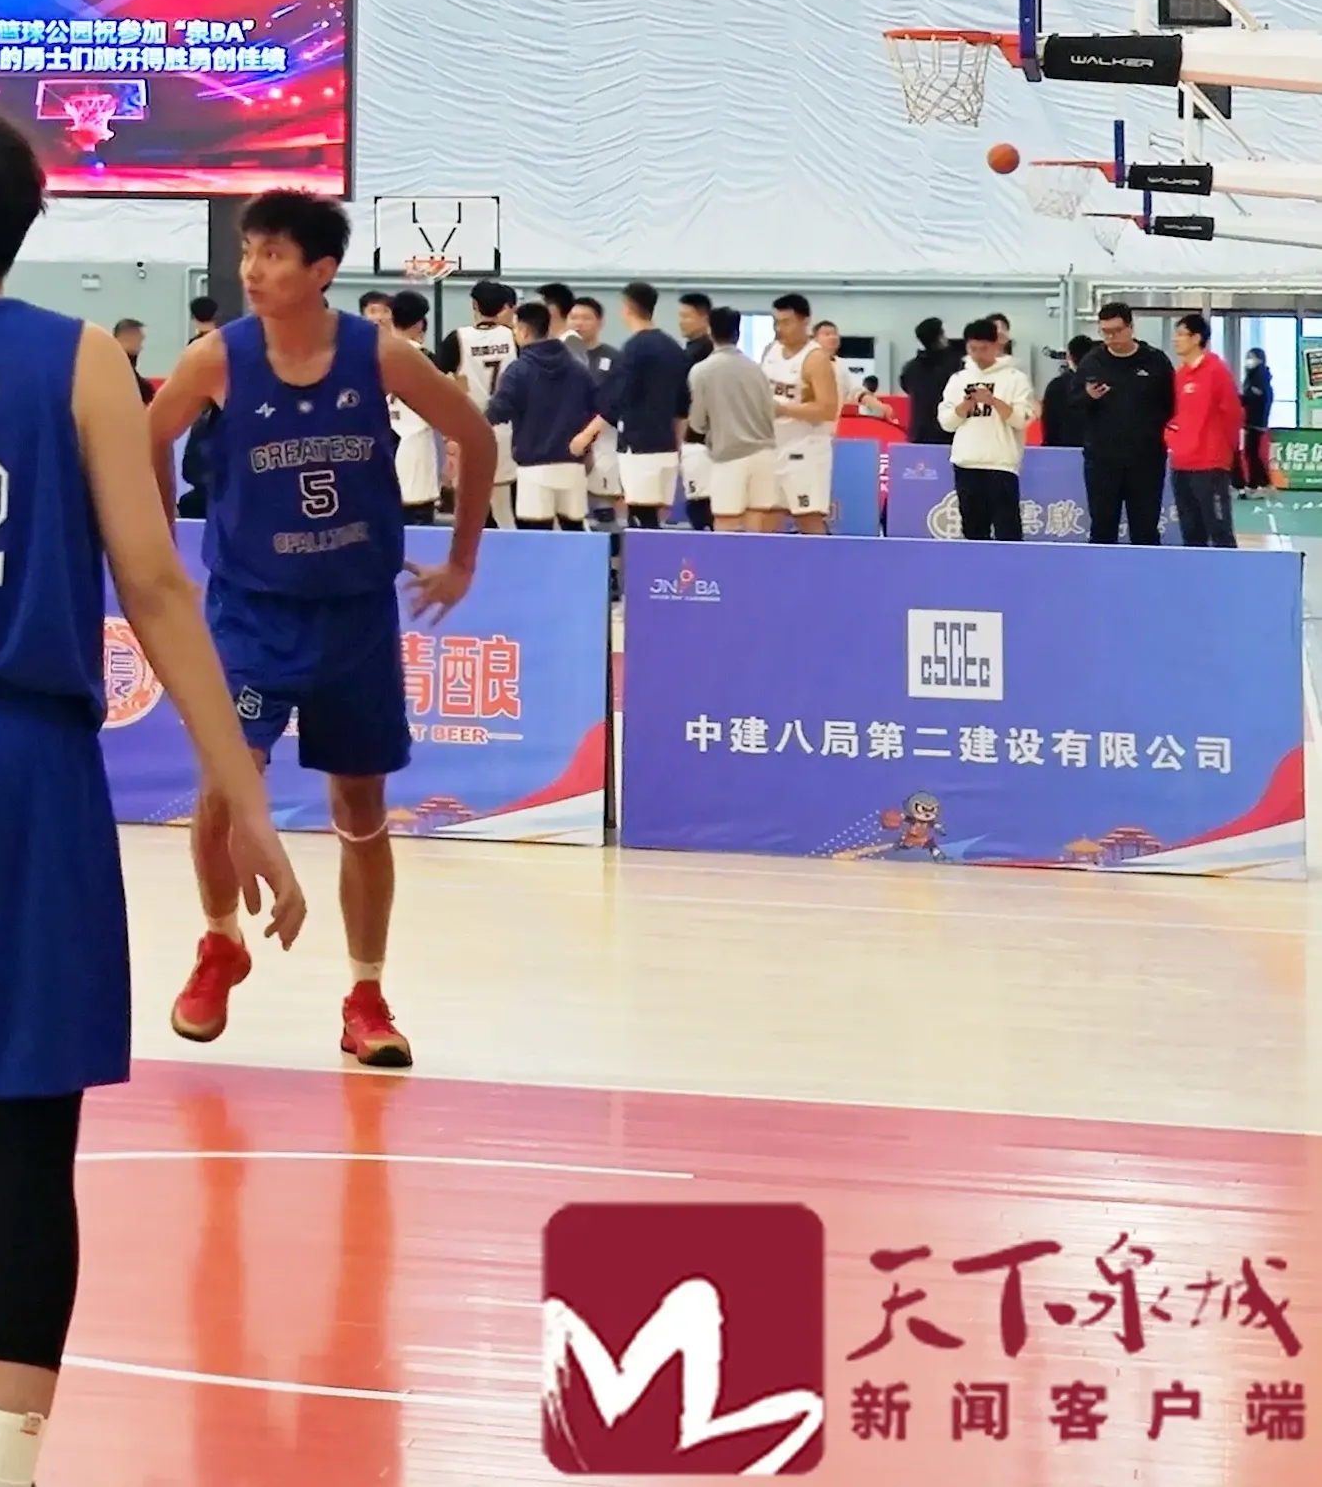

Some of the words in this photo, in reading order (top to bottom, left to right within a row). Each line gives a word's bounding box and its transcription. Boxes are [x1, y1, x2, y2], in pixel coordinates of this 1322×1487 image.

[1070, 55, 1155, 68] WALKER
[1147, 175, 1201, 186] WALKER
[250, 435, 376, 474] GREATEST
[299, 468, 340, 519] 5
[432, 724, 487, 744] BEER
[685, 713, 1233, 775] 中建八局第二建设有限公司
